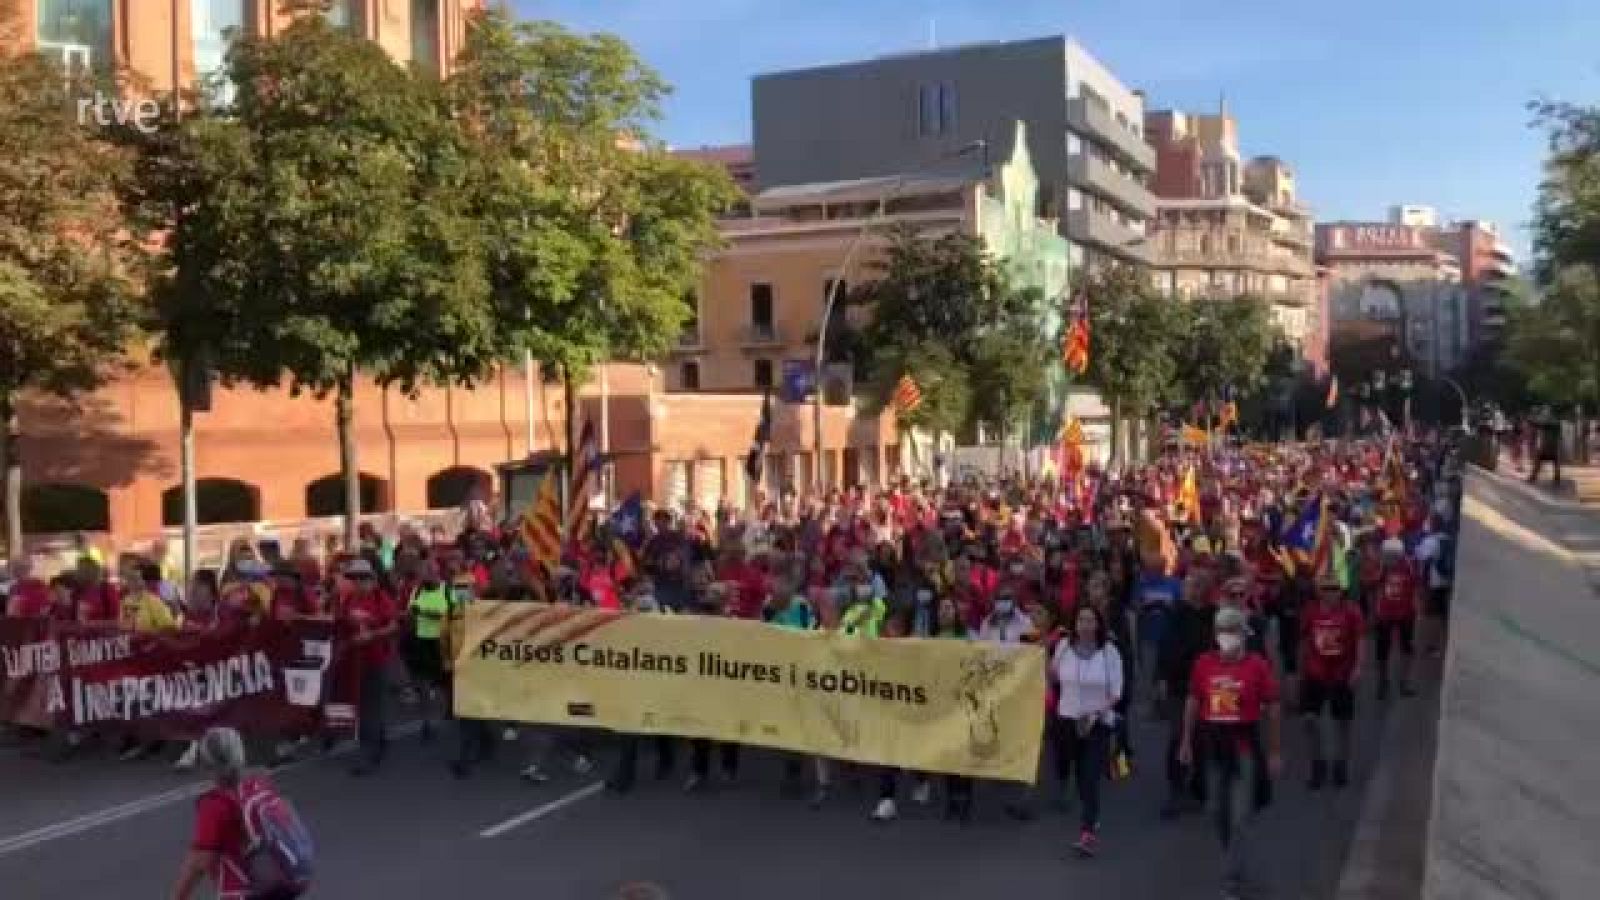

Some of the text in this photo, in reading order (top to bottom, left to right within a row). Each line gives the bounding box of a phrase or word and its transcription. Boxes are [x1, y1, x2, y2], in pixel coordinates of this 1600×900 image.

[479, 639, 929, 705] Països Catalans lliures i sobirans
